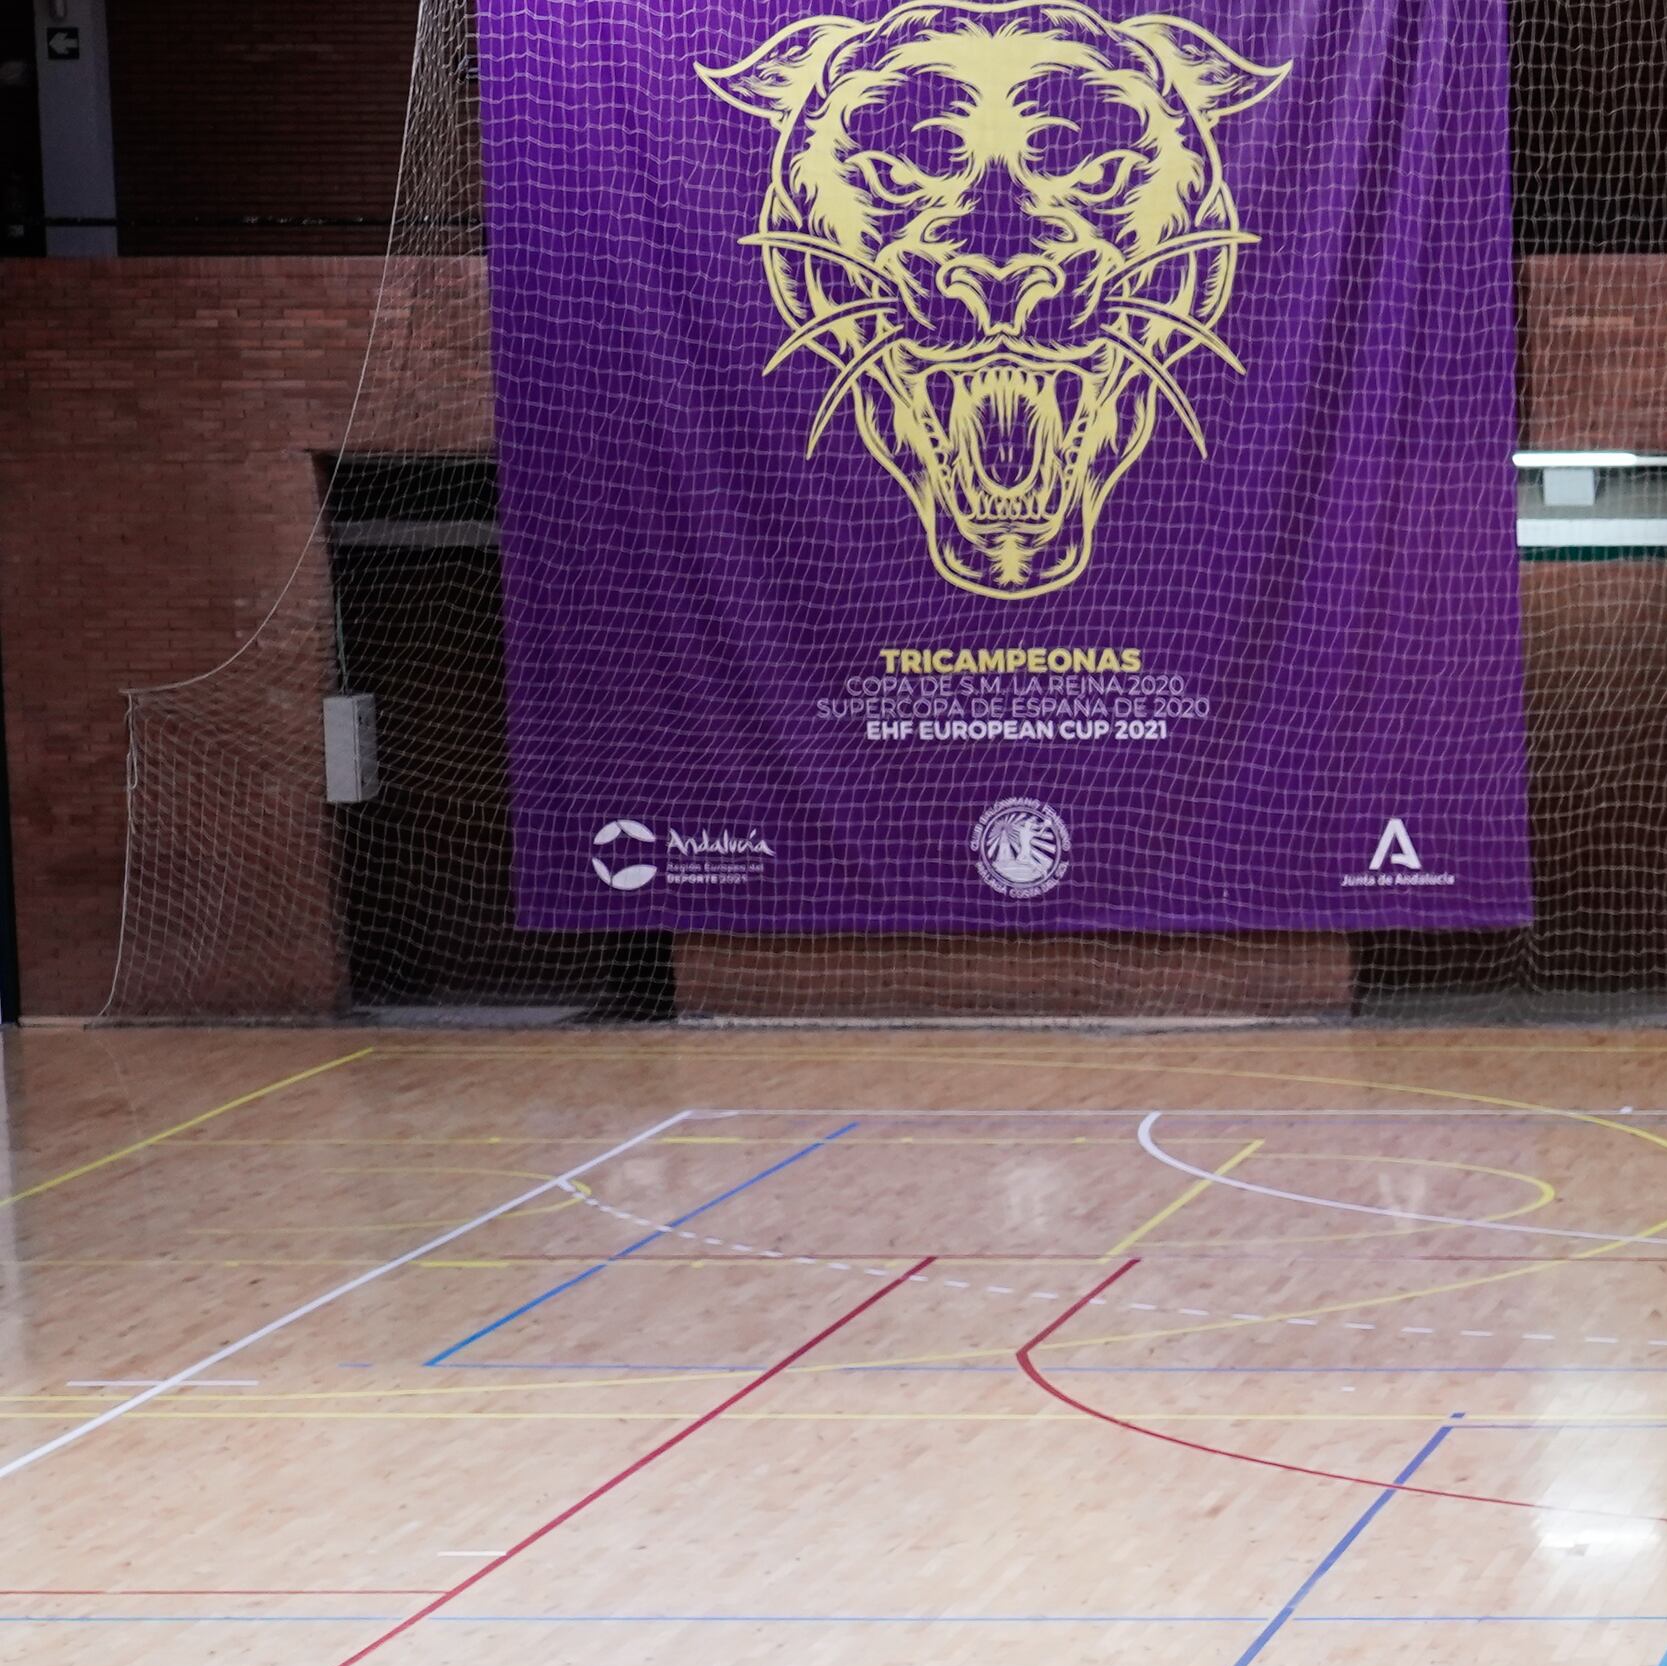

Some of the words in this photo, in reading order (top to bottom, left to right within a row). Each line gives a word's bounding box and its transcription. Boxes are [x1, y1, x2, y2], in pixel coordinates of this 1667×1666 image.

[880, 647, 1142, 673] TRICAMPEONAS
[846, 676, 913, 697] COPA
[920, 676, 951, 697] DE
[1014, 676, 1050, 696] LA
[1055, 675, 1123, 696] REINA
[1127, 675, 1184, 695] 2020
[816, 698, 964, 719] SUPERCOPA
[971, 698, 1004, 719] DE
[1114, 698, 1147, 718] DE
[1154, 697, 1210, 718] 2020
[866, 720, 913, 741] EHF
[919, 720, 1054, 740] EUROPEAN
[1059, 720, 1110, 740] CUP
[1114, 719, 1168, 740] 2021
[667, 828, 776, 857] Andalucía
